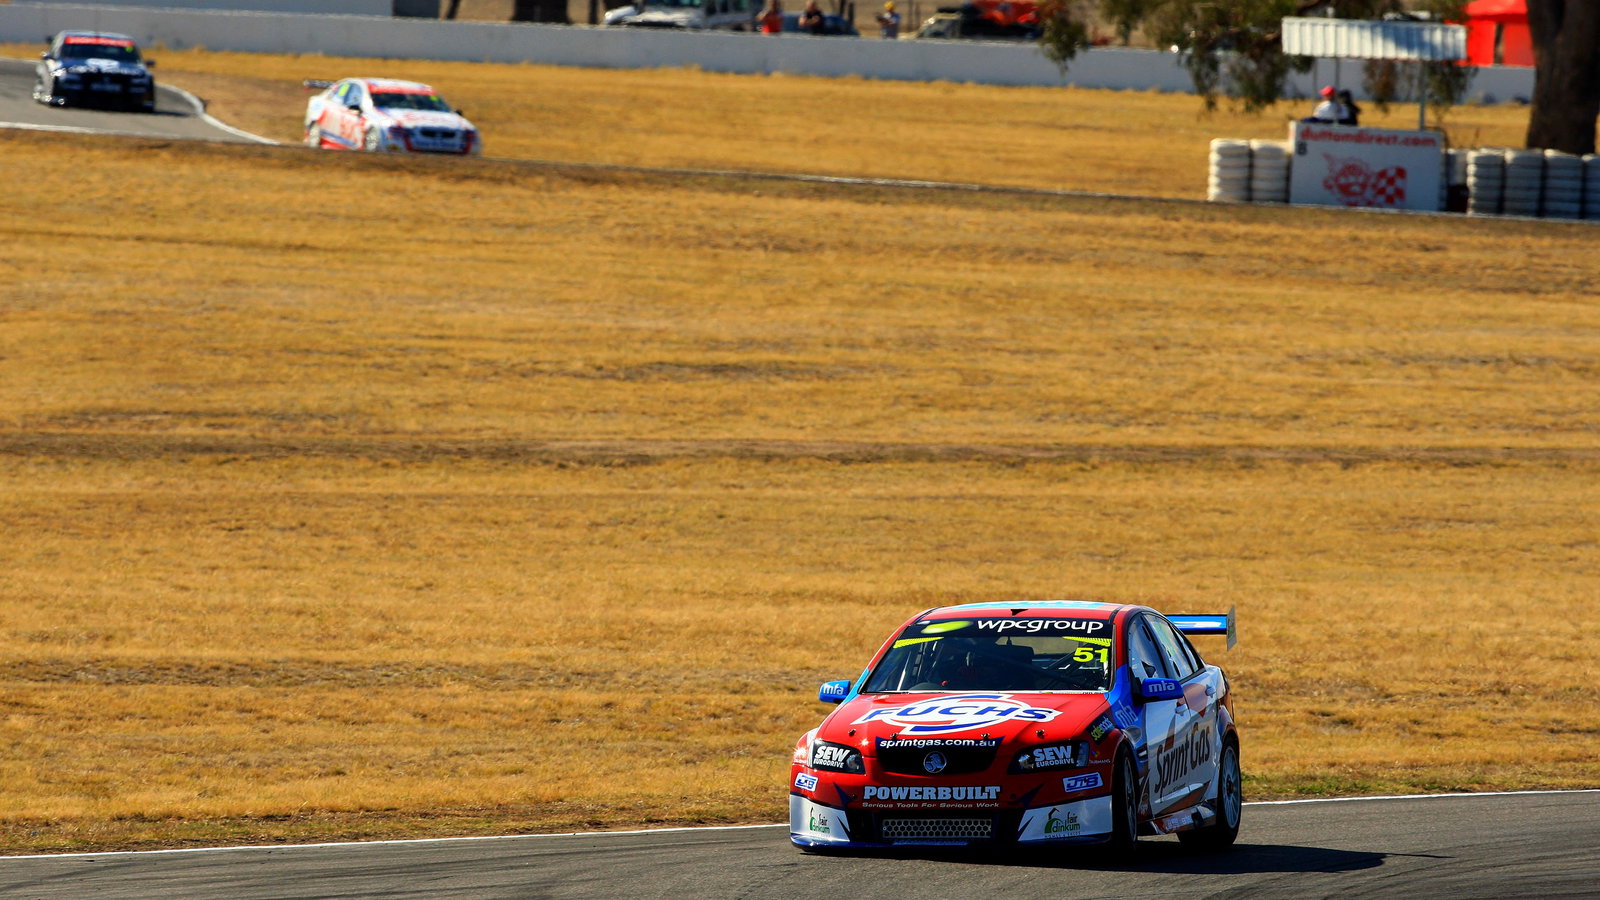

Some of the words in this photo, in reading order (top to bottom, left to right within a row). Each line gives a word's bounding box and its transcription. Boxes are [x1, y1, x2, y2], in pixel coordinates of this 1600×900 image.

[1301, 127, 1436, 146] duttondirect.com
[977, 620, 1104, 634] wpcgroup
[1073, 647, 1109, 663] 51
[861, 705, 1054, 722] FUCHS
[879, 738, 996, 748] sprintgas.com.au
[815, 745, 851, 762] SEW
[1033, 745, 1072, 762] SEW
[813, 758, 845, 769] EURODRIVE
[1036, 758, 1075, 768] EURODRIVE
[1154, 731, 1190, 803] Sprint
[1190, 721, 1211, 770] Gas
[863, 785, 1001, 801] POWERBUILT
[862, 801, 894, 809] Serious
